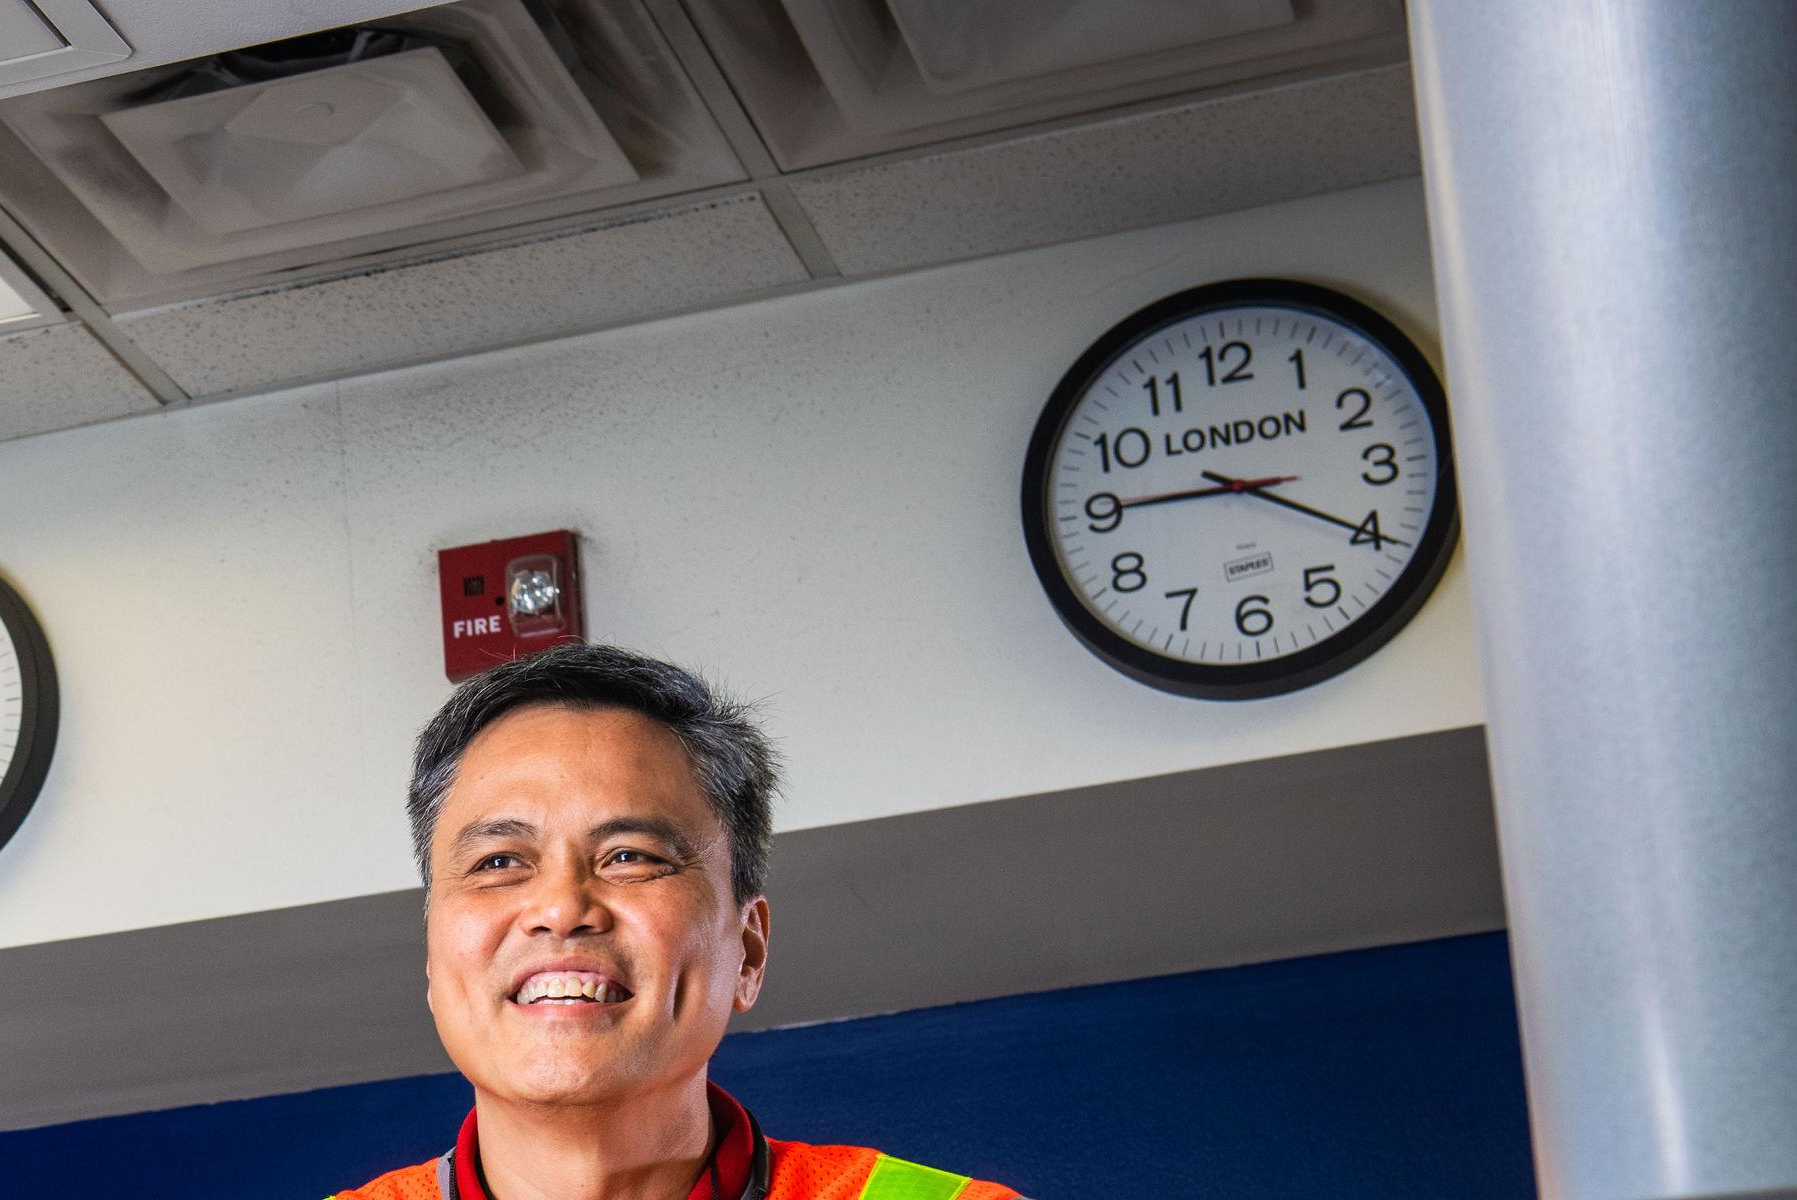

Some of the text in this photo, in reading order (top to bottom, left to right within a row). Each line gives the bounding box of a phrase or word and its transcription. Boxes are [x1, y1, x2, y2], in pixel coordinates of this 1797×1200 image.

[1198, 341, 1254, 386] 12
[1289, 349, 1306, 389] 1
[1143, 372, 1183, 416] 11
[1336, 387, 1373, 432] 2
[1094, 427, 1151, 474] 10
[1165, 410, 1306, 456] LONDON
[1361, 443, 1399, 486] 3
[1084, 492, 1124, 534] 9
[1348, 509, 1383, 551] 4
[1111, 551, 1147, 593] 8
[1303, 564, 1341, 608] 5
[453, 615, 501, 638] FIRE
[1164, 588, 1198, 632] 7
[1234, 595, 1273, 636] 6
